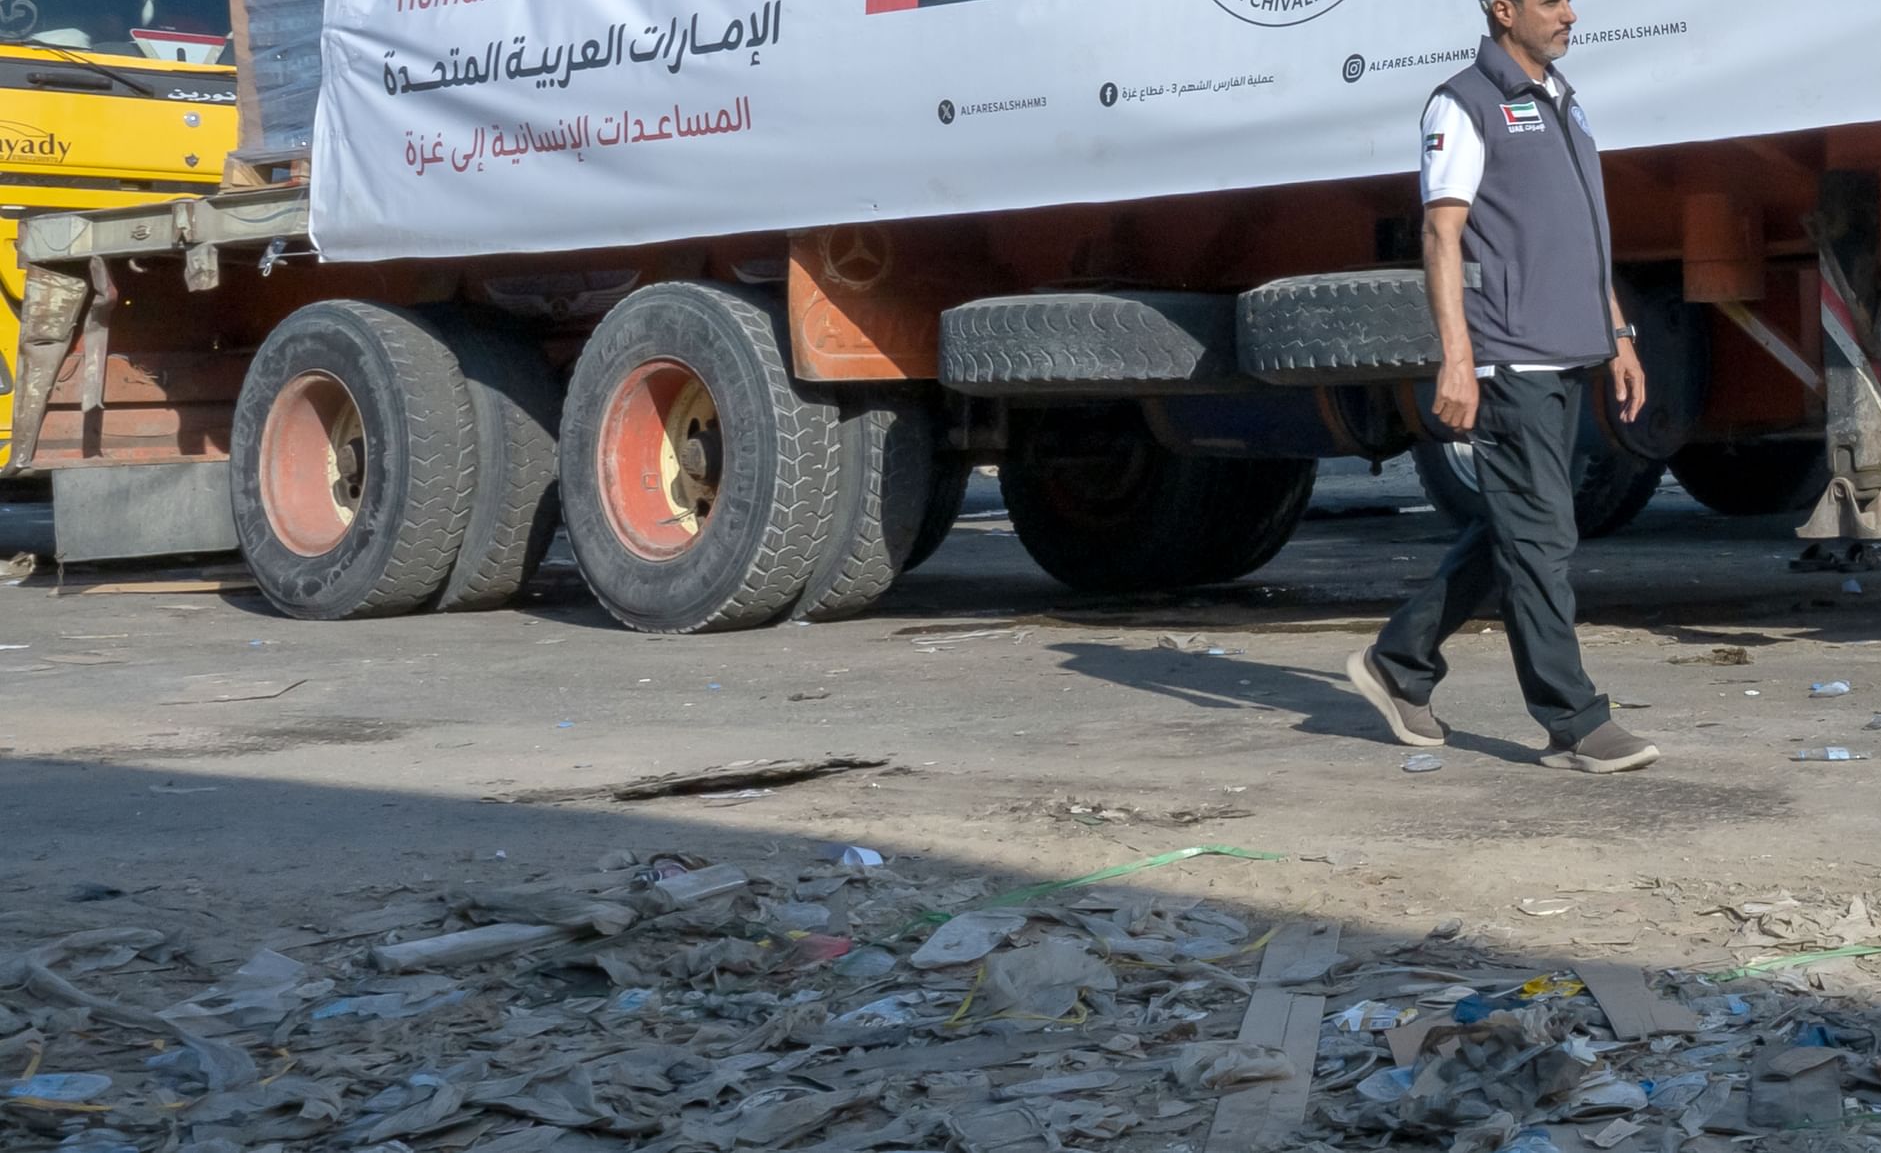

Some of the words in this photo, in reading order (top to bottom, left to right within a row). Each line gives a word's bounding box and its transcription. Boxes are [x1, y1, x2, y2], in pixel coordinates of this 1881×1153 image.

[631, 0, 781, 74] الإمارات
[1571, 21, 1688, 46] ALFARESALSHAHM3
[383, 40, 502, 95] المتحدة
[505, 22, 625, 89] العربية
[1369, 48, 1477, 72] ALFARES.ALSHAHM3
[1121, 87, 1138, 100] غزة
[1139, 85, 1165, 102] قطاع
[1178, 79, 1212, 96] الشهم
[1213, 75, 1246, 92] الفارس
[1247, 75, 1275, 87] عملية
[960, 96, 1047, 116] ALFARESALSHAHM3
[596, 96, 751, 145] المساعدات
[451, 126, 485, 173] إلى
[492, 114, 589, 165] الإنسانية
[405, 130, 444, 176] غزة
